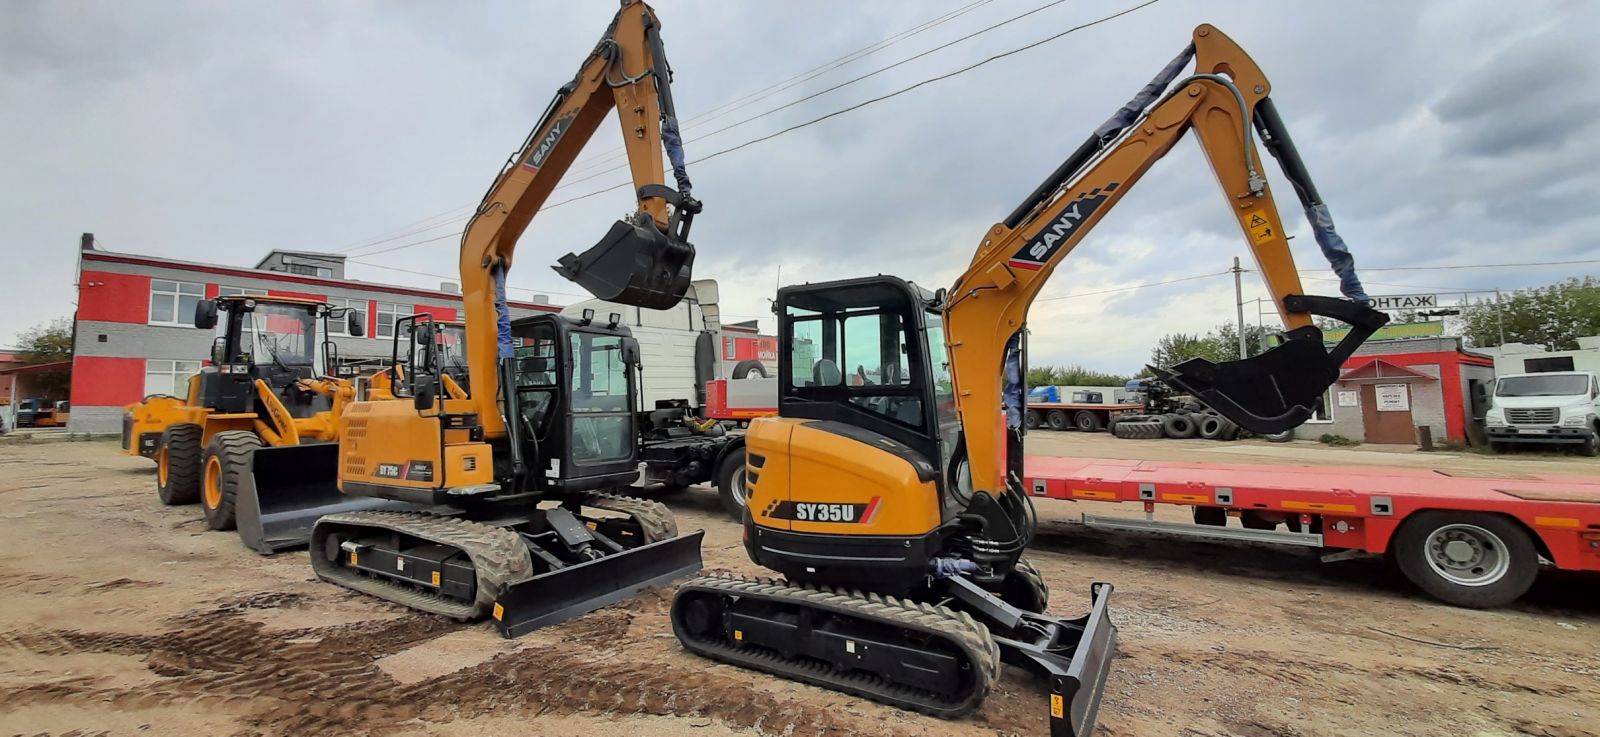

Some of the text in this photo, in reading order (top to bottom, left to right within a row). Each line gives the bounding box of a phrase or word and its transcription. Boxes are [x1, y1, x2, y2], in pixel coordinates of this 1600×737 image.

[533, 122, 561, 165] SANY
[1029, 203, 1082, 260] SANY
[380, 464, 399, 477] SY75C
[796, 503, 854, 522] SY35U
